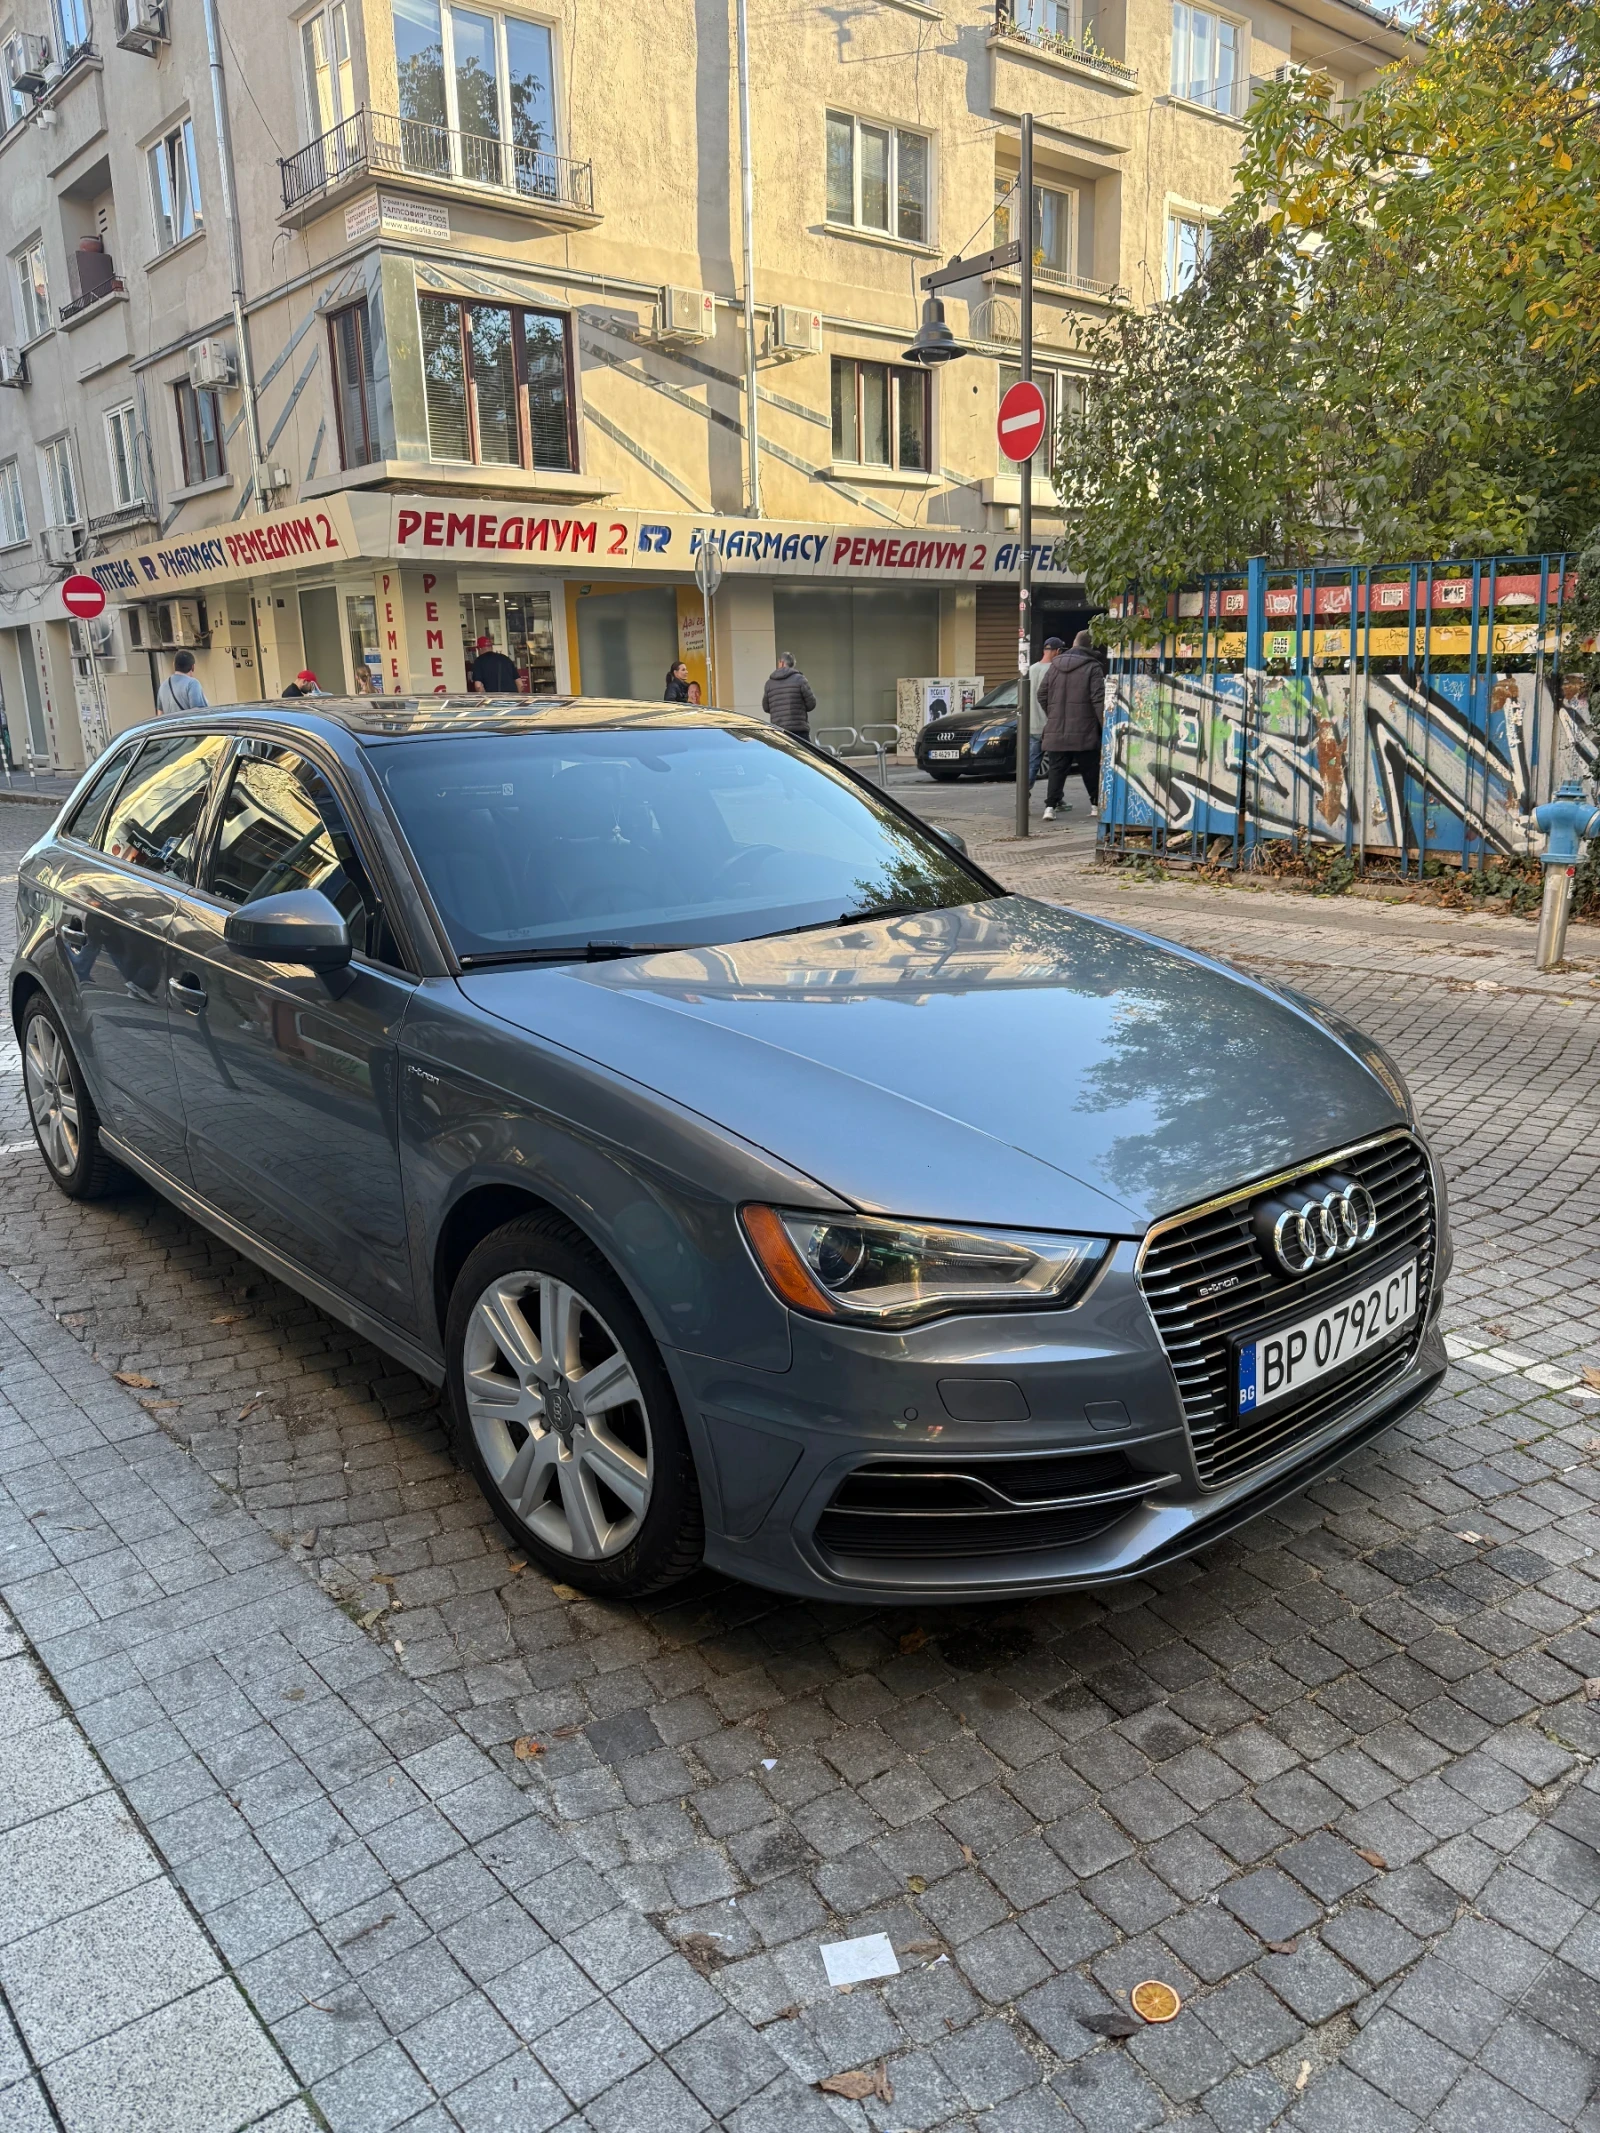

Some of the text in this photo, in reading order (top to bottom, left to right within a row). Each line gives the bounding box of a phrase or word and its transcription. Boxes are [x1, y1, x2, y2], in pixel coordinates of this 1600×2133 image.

[385, 220, 448, 237] www.alpsofia.com
[225, 513, 339, 566] РЕМЕДИУМ 2
[397, 509, 628, 555] РЕМЕДИУМ 2
[157, 538, 229, 578] PHARMACY
[832, 536, 987, 571] РЕМЕДИУМ 2
[91, 558, 139, 593] АПТЕКА
[407, 1065, 440, 1085] e-tron
[1200, 1276, 1239, 1296] e-tron
[1263, 1267, 1414, 1396] BP 0792 CT
[1239, 1385, 1255, 1405] BG
